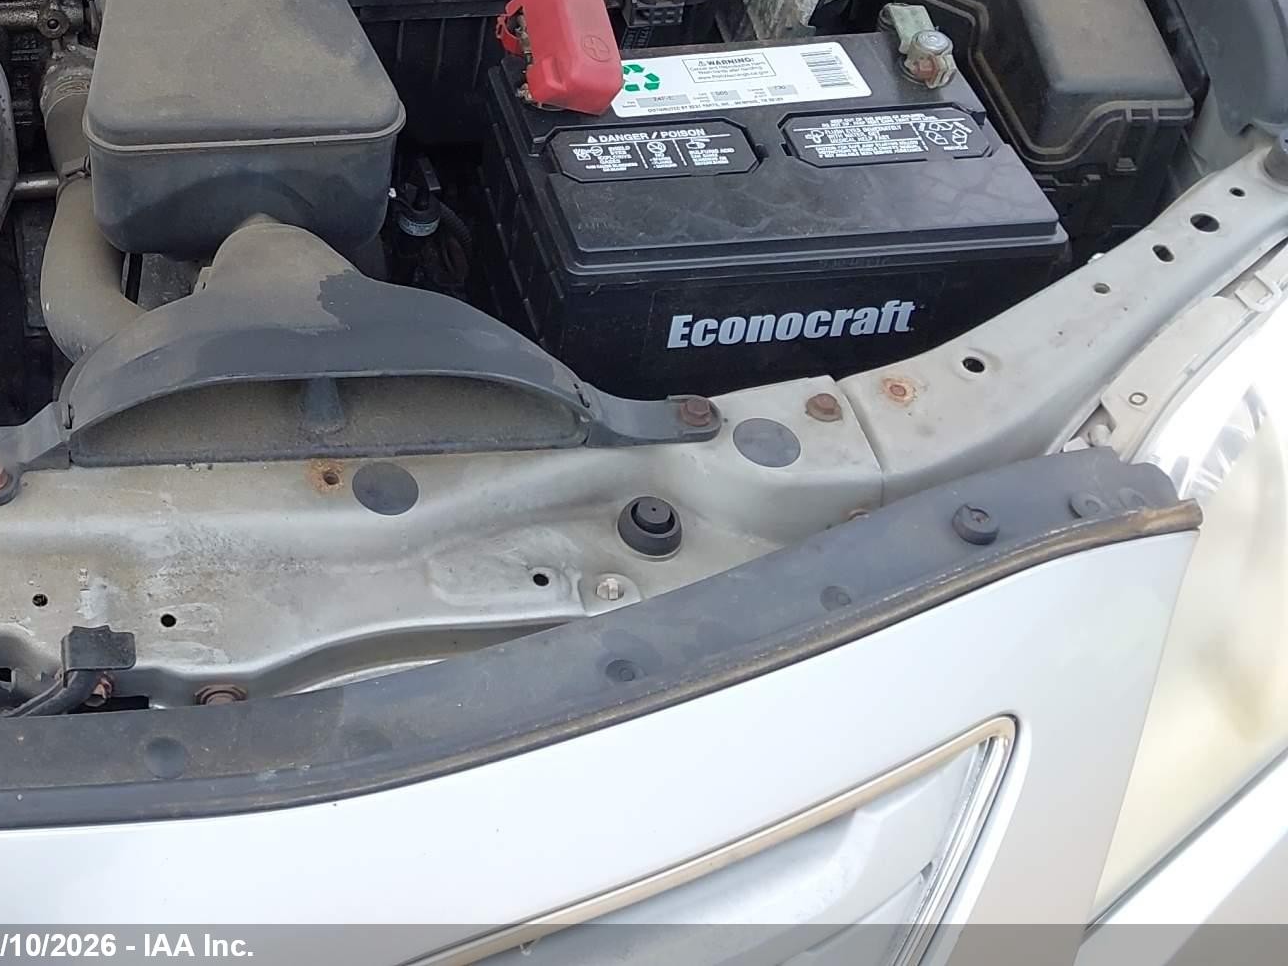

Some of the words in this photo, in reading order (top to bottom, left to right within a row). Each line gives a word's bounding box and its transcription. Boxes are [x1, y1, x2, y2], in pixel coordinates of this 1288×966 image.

[708, 57, 754, 66] WARNING:
[598, 132, 649, 143] DANGER
[652, 131, 658, 139] /
[660, 128, 706, 139] POISON
[667, 299, 916, 349] Econocraft
